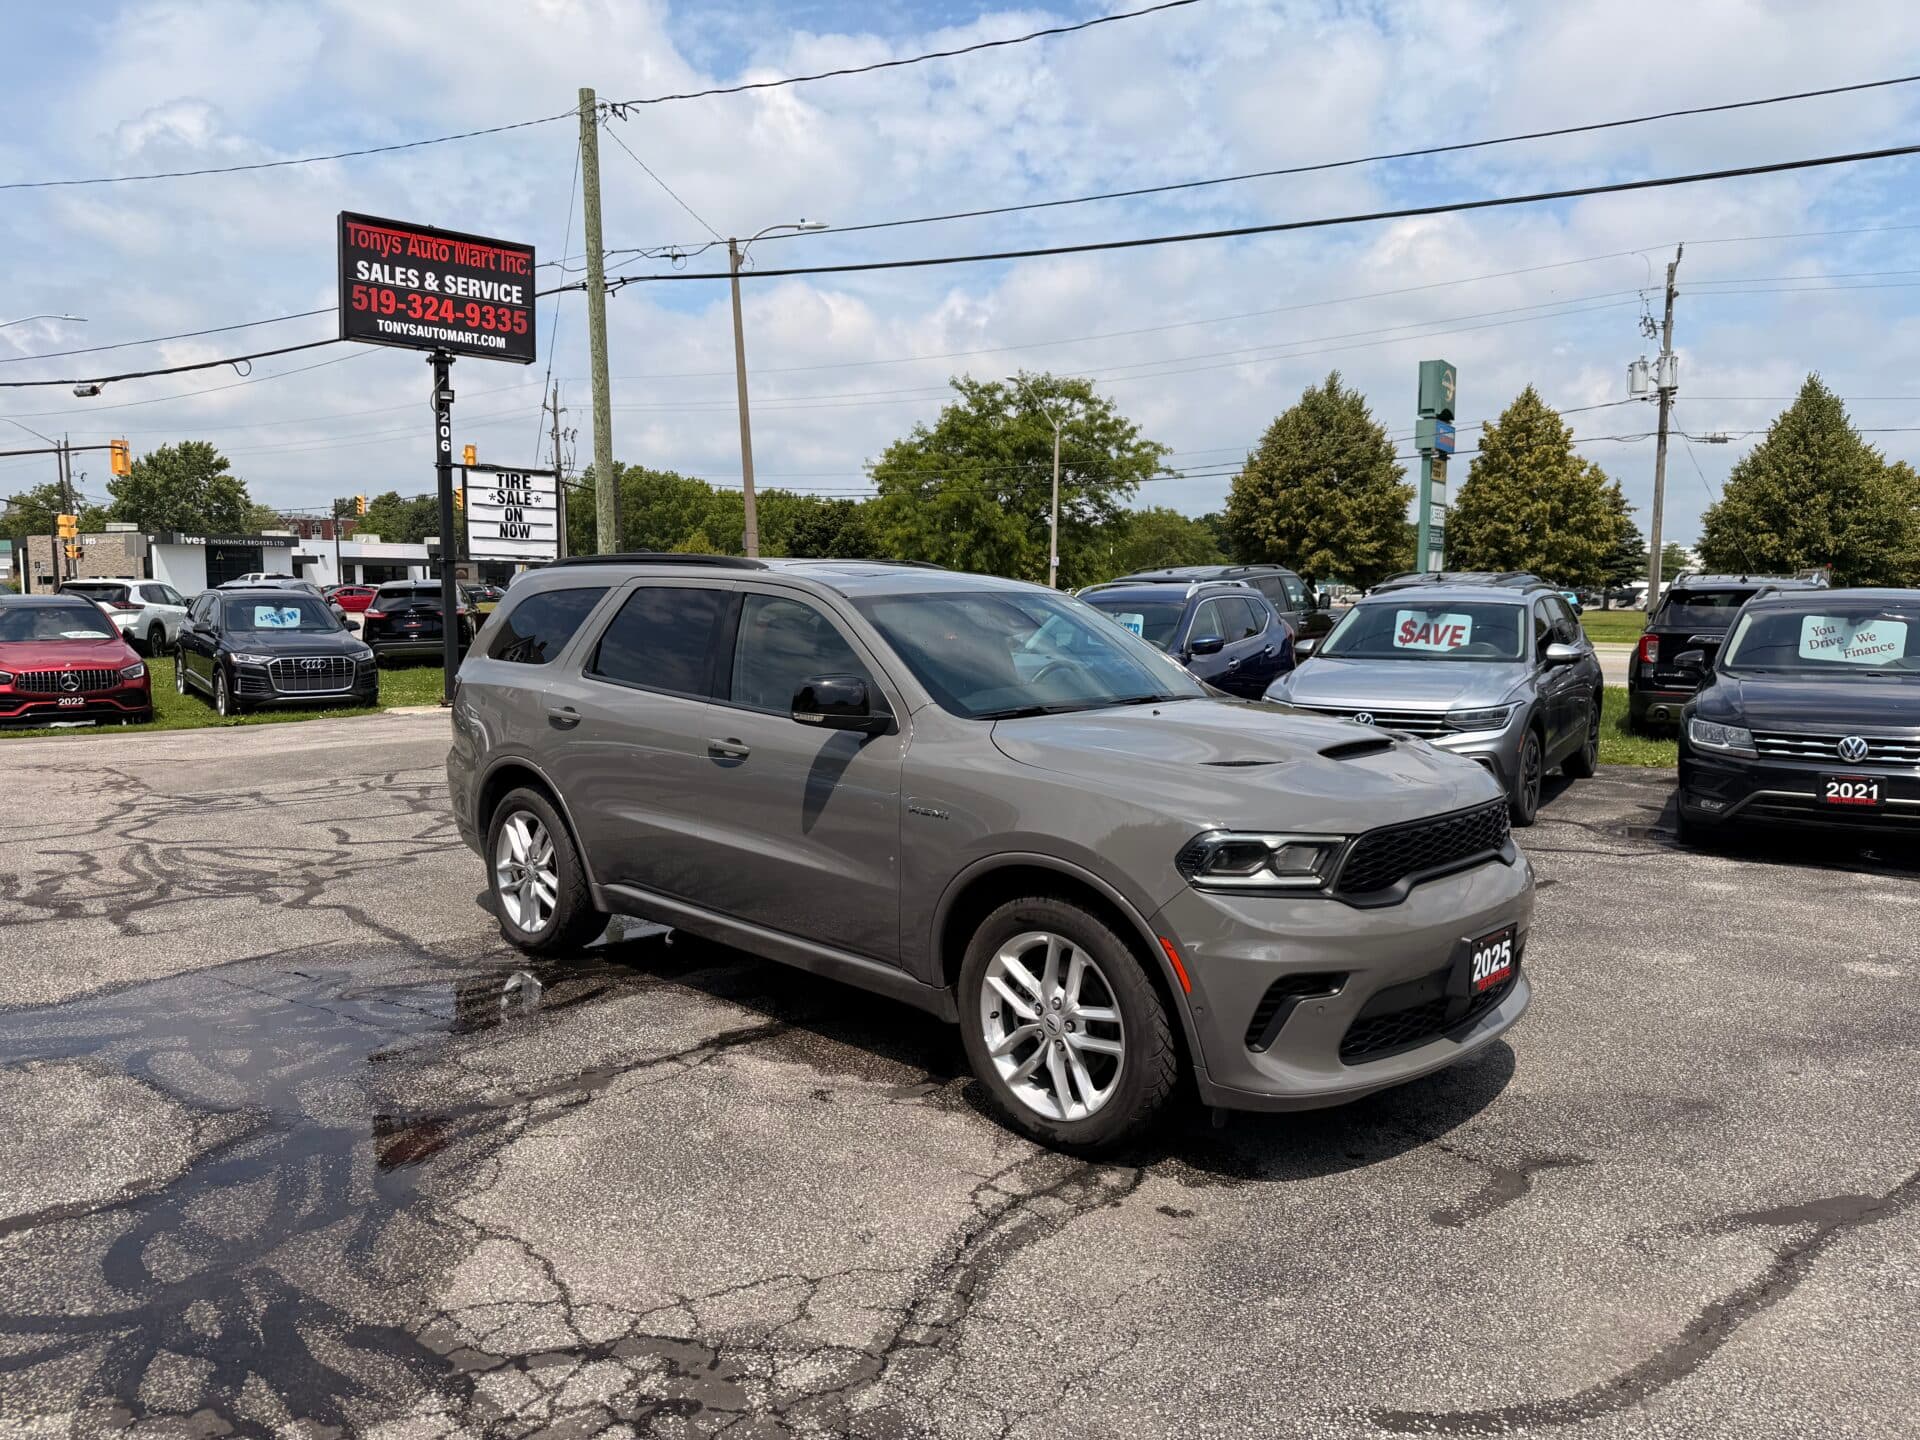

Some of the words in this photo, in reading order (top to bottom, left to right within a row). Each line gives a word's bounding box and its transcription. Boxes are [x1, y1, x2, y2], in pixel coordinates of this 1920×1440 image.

[346, 222, 402, 258] Tonys
[407, 232, 450, 263] Auto
[454, 242, 495, 271] Mart
[499, 248, 532, 277] Inc.
[356, 260, 420, 289] SALES
[424, 271, 440, 292] &
[444, 275, 523, 305] SERVICE
[352, 284, 528, 335] 519-324-9335
[377, 319, 506, 349] TONYSAUTOMART.COM
[496, 473, 531, 490] TIRE
[505, 507, 523, 522] ON
[181, 533, 207, 545] ives
[500, 523, 531, 539] NOW
[1398, 617, 1466, 647] $AVE
[1811, 625, 1836, 637] You
[1855, 632, 1877, 644] We
[1808, 636, 1844, 650] Drive
[1843, 642, 1896, 659] Finance
[58, 697, 85, 706] 2022
[1826, 782, 1878, 801] 2021
[1473, 940, 1511, 982] 2025
